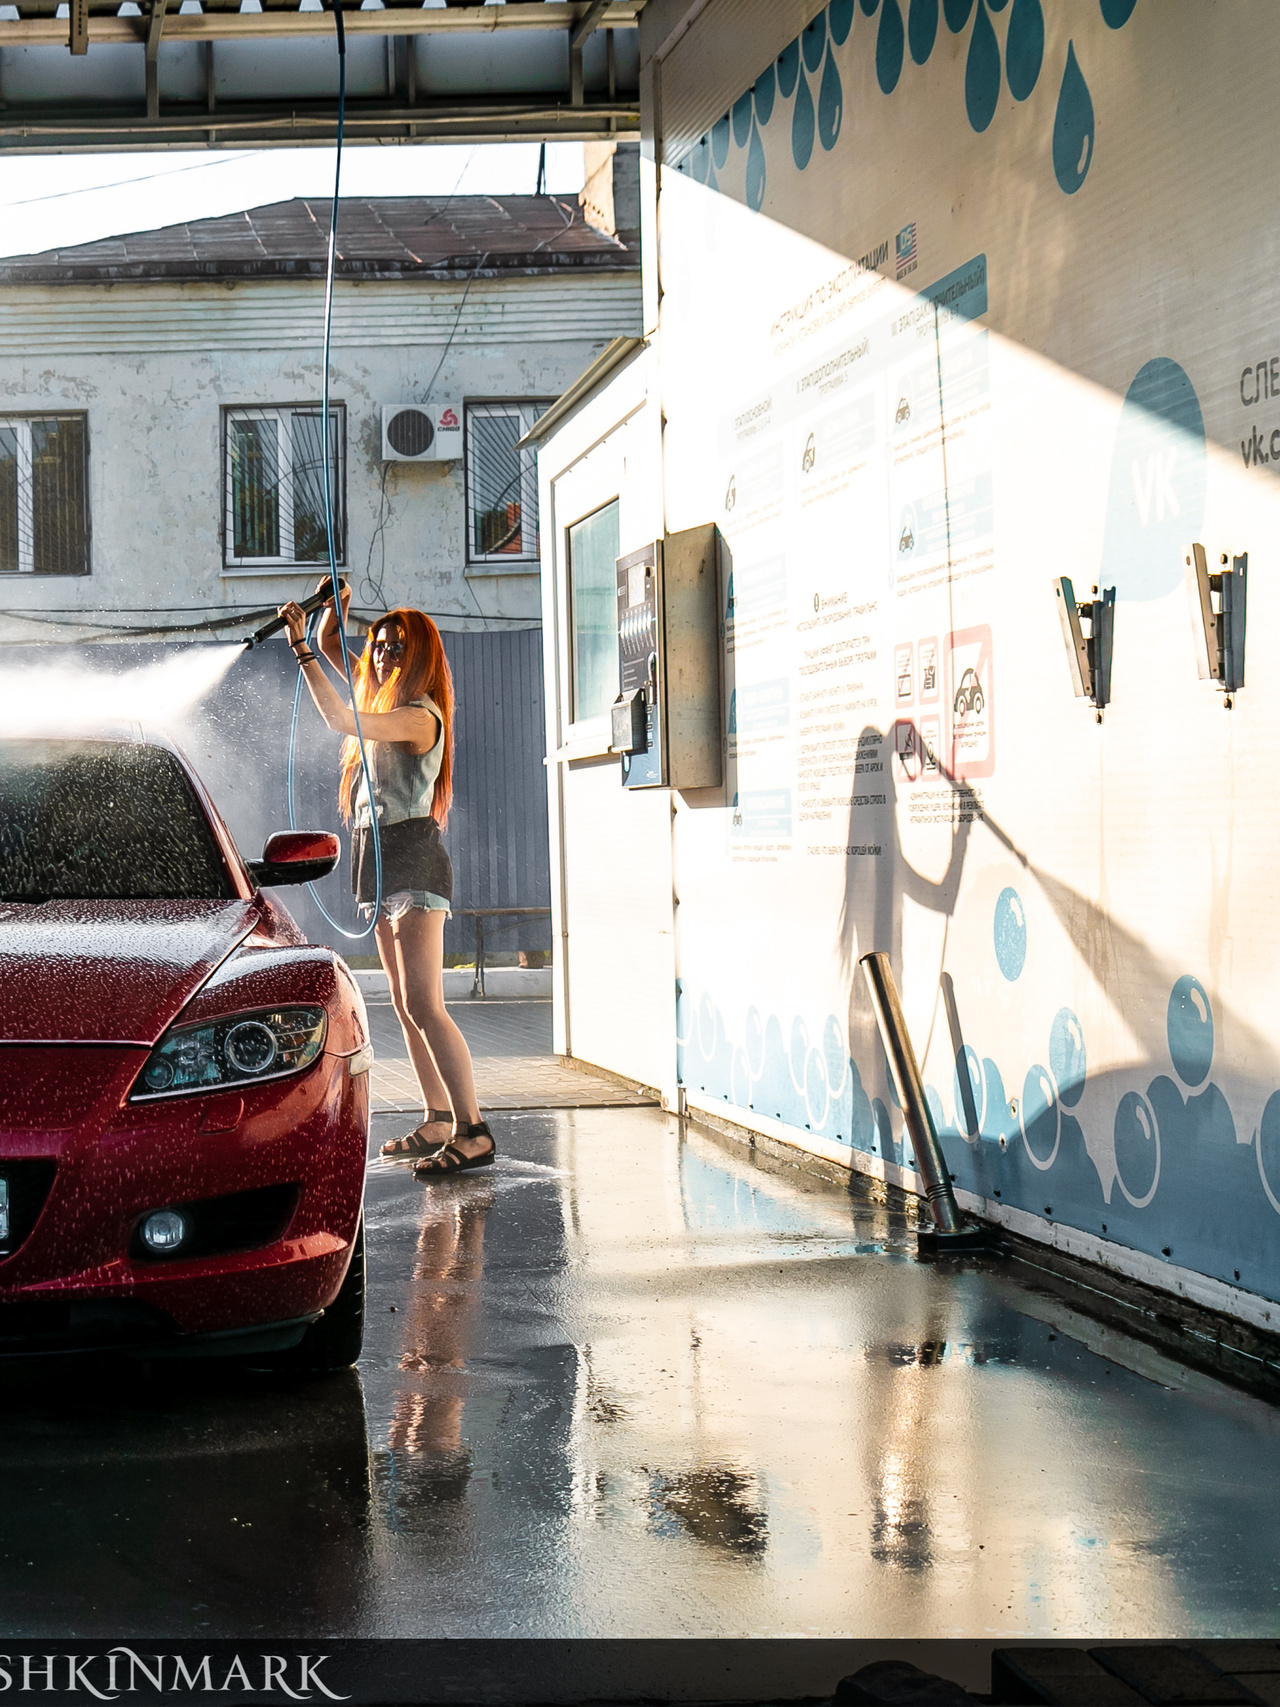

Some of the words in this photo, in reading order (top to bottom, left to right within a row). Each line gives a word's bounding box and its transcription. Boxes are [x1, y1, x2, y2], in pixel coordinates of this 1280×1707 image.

[815, 285, 826, 306] ПО
[828, 240, 889, 299] ЭКСПЛУАТАЦИИ
[1131, 445, 1180, 527] VK
